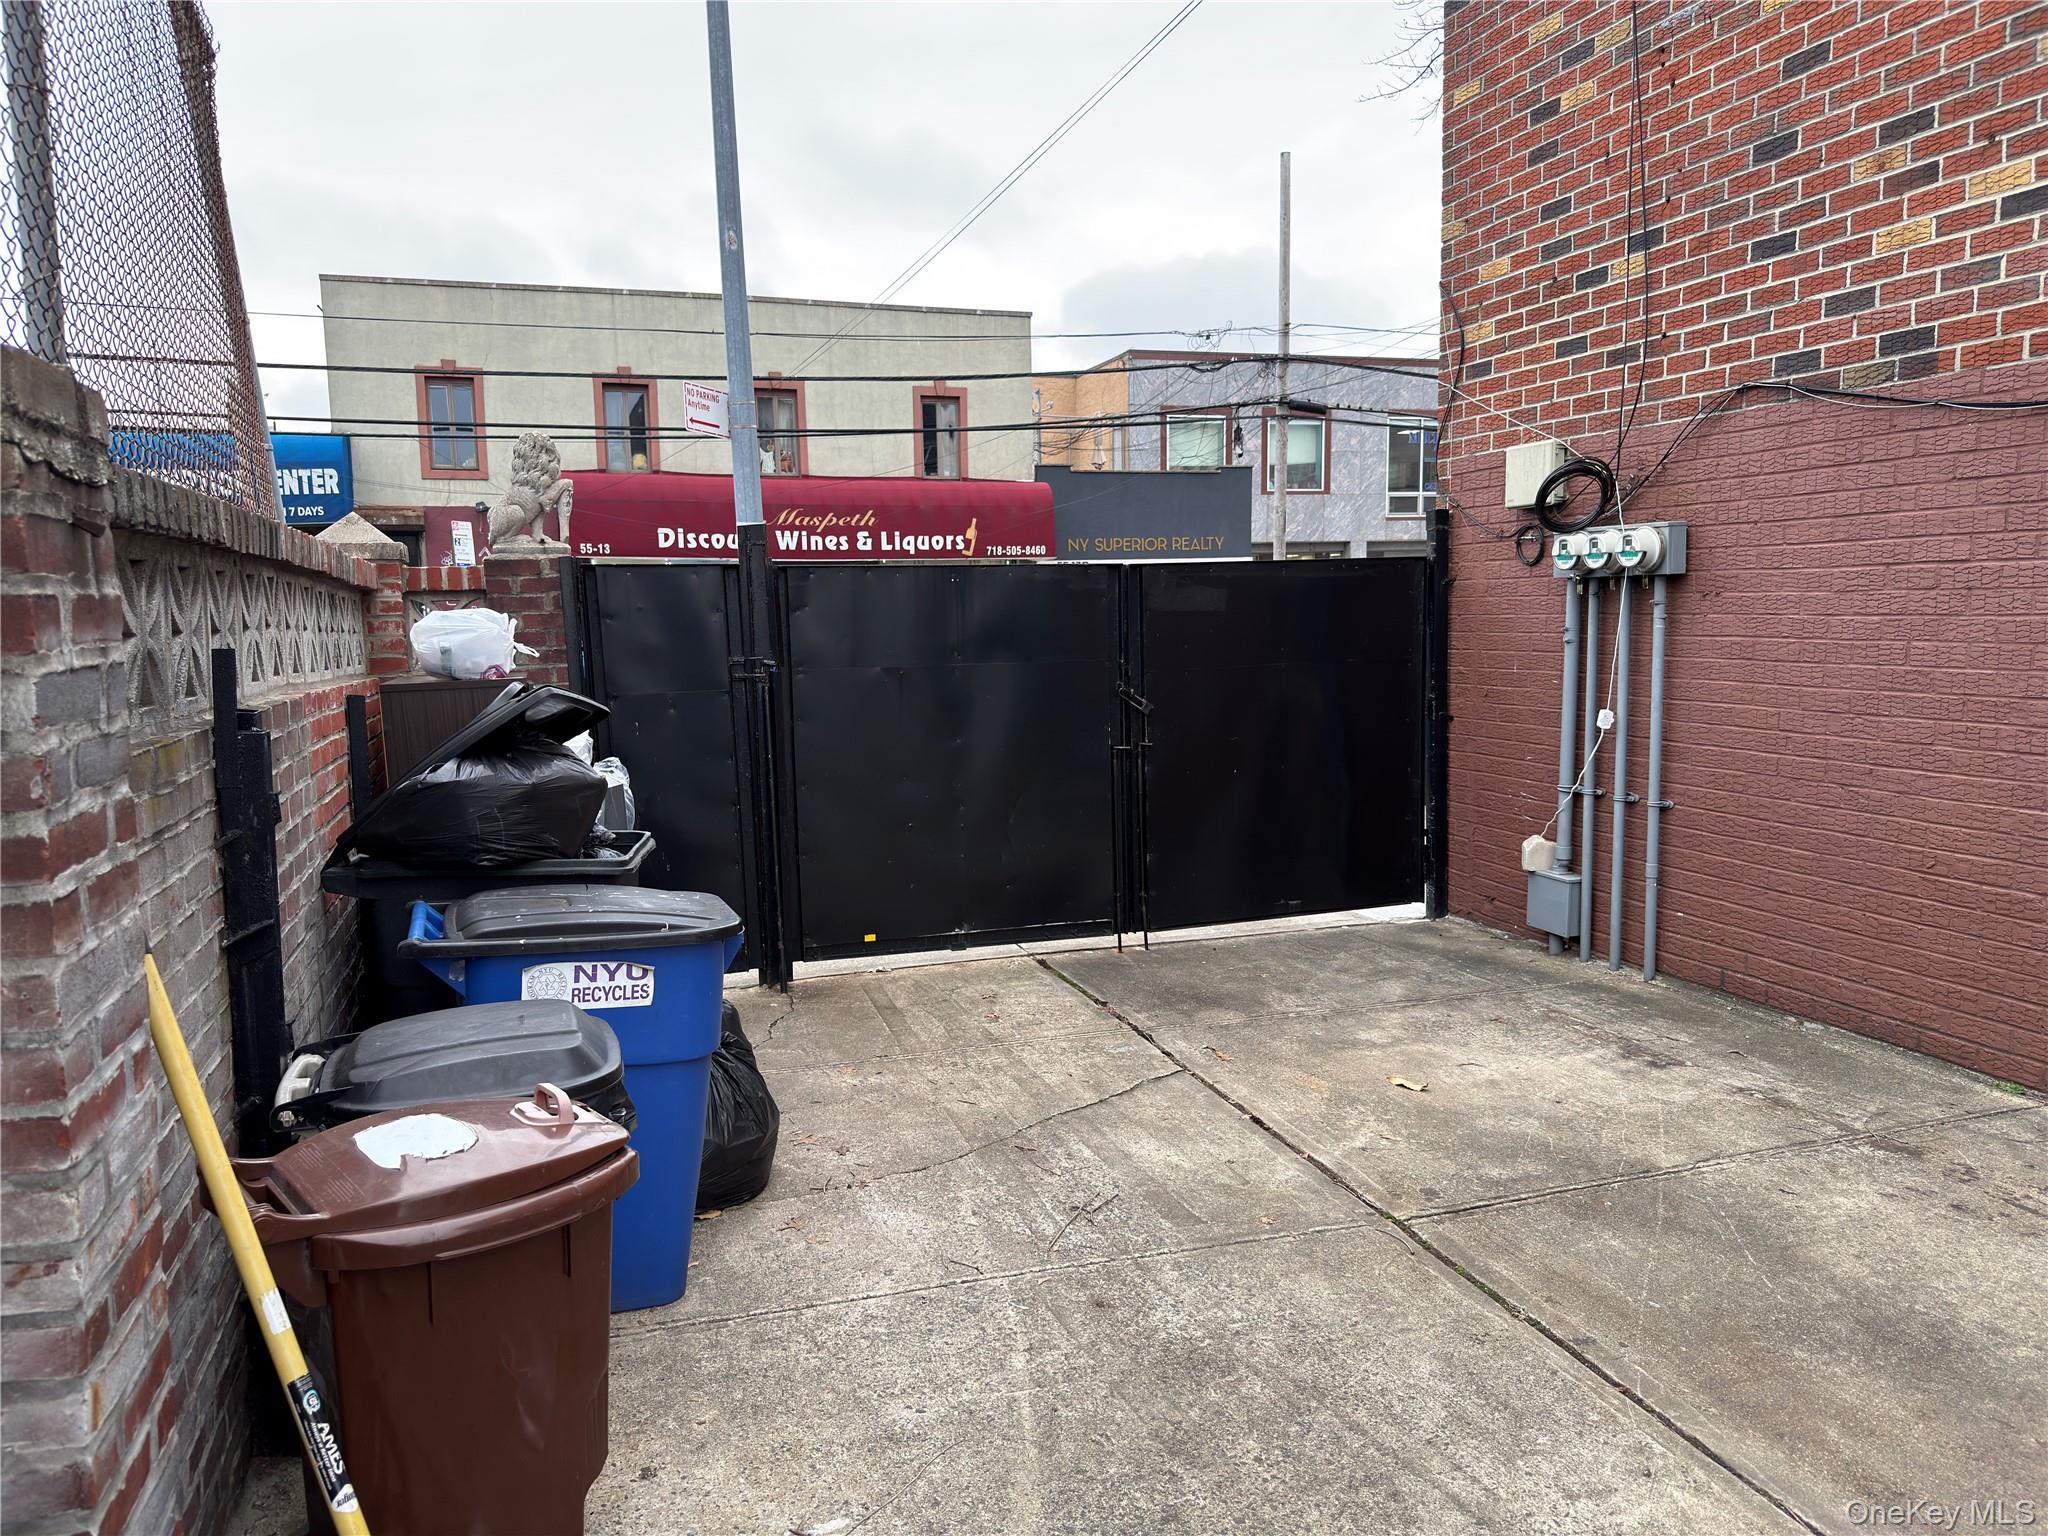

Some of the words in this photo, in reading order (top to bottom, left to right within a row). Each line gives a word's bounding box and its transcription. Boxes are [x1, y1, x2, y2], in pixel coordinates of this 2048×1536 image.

[687, 387, 695, 397] NO
[696, 390, 720, 404] PARKING
[687, 398, 711, 412] Anytime
[288, 506, 296, 517] 7
[297, 505, 325, 517] DAYS
[767, 508, 879, 533] Maspeth
[579, 543, 611, 555] 55-13
[657, 527, 739, 550] Discou
[775, 530, 849, 551] Wines
[856, 530, 873, 551] &
[880, 530, 965, 555] Liquors
[1067, 538, 1089, 552] NY
[1095, 537, 1167, 552] SUPERIOR
[1172, 536, 1225, 551] REALTY
[986, 544, 1046, 556] 718-505-8460
[574, 963, 649, 984] NYU
[571, 983, 650, 1004] RECYCLES
[317, 1422, 344, 1475] AMES
